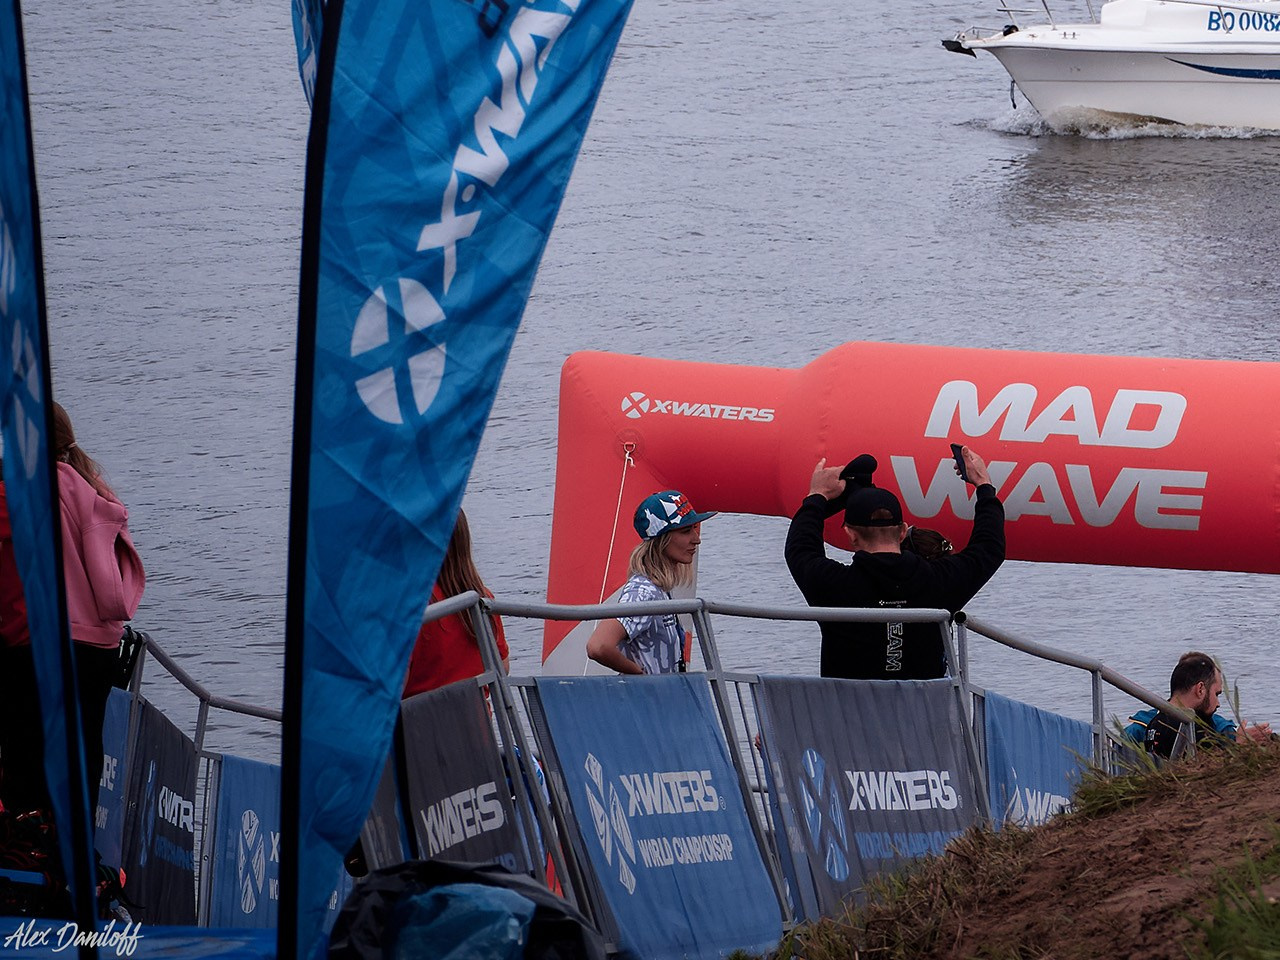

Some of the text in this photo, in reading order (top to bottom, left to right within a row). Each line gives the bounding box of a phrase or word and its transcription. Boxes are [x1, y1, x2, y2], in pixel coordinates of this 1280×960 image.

[924, 380, 1188, 449] MAD
[890, 455, 1208, 531] WAVE
[886, 622, 903, 671] EAM
[672, 834, 733, 864] CAMPIOSHP
